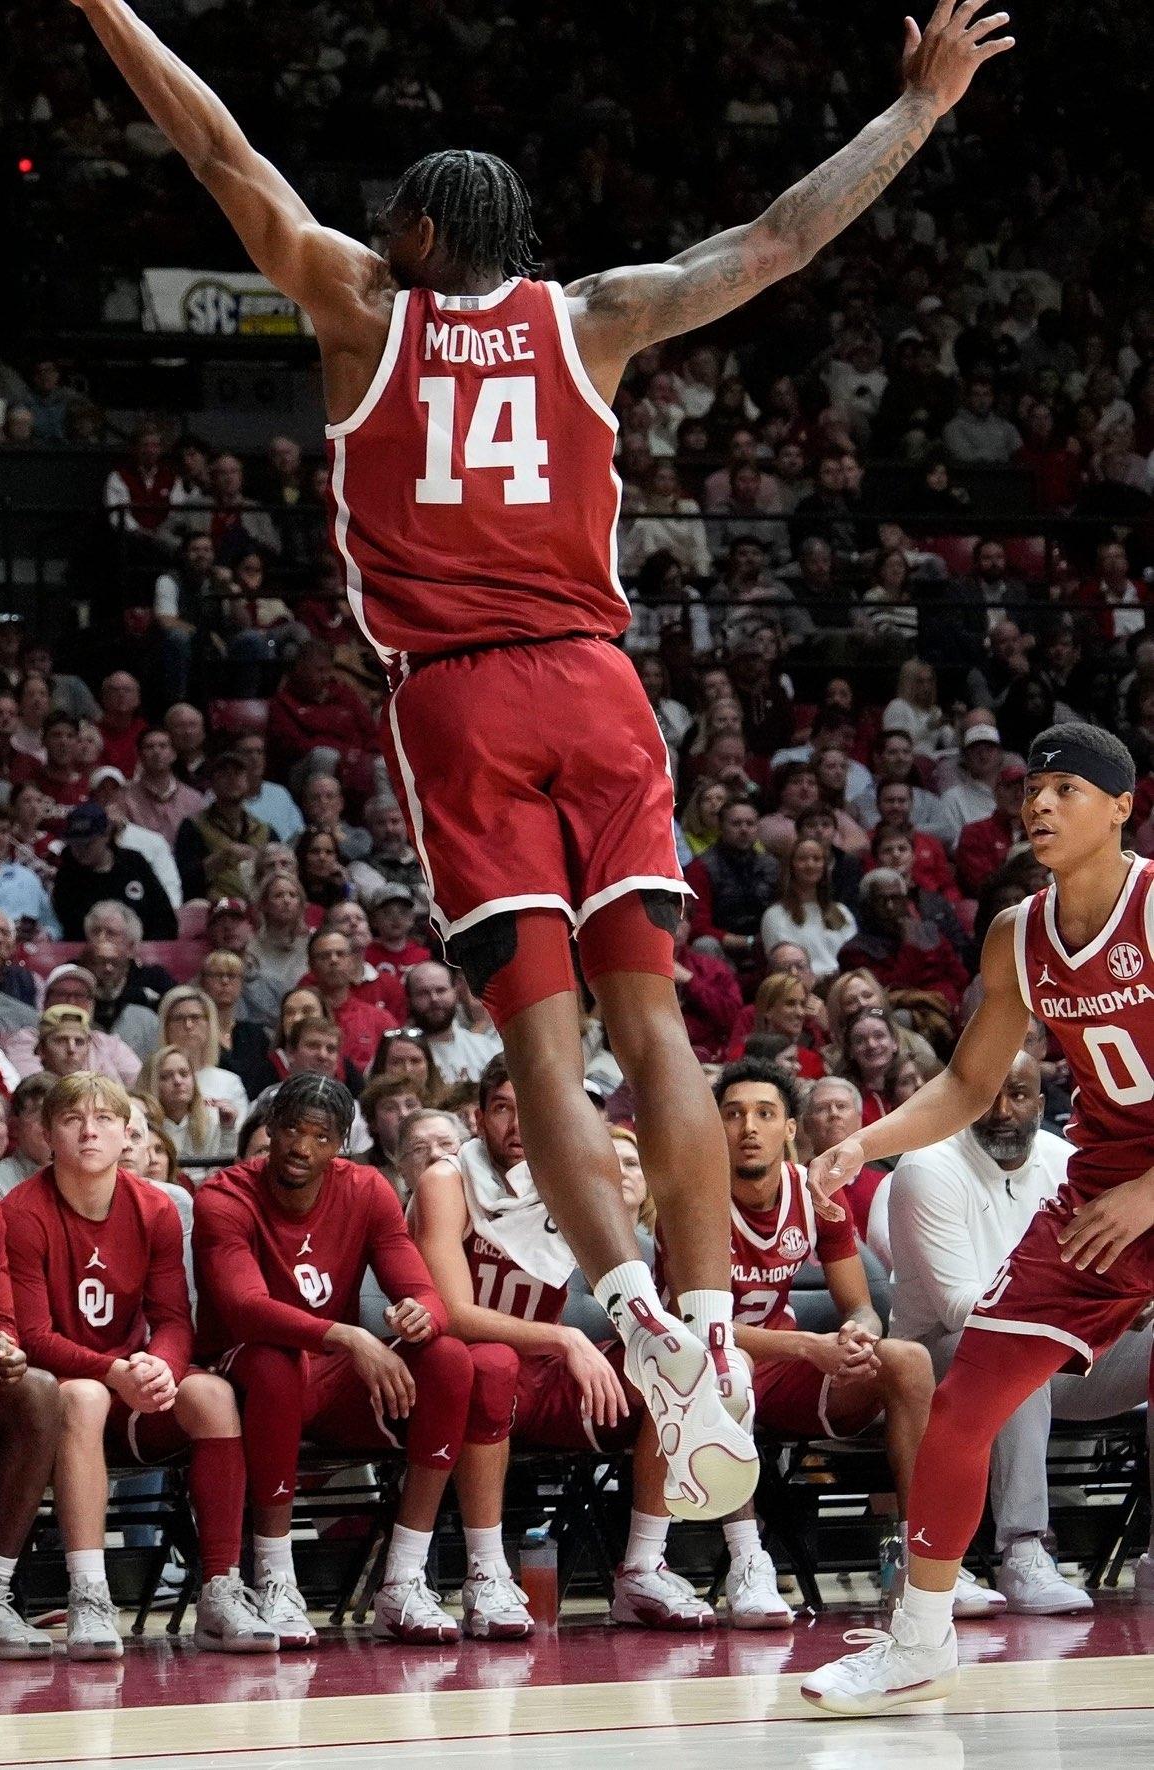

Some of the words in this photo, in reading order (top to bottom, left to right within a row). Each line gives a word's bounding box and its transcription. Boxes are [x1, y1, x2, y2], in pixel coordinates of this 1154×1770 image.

[424, 322, 535, 367] MOORE
[415, 376, 551, 504] 14
[1108, 944, 1143, 979] SEC
[1040, 983, 1154, 1018] OKLAHOMA
[1082, 1025, 1154, 1106] 0
[78, 1278, 114, 1327] OU
[293, 1263, 333, 1309] OU
